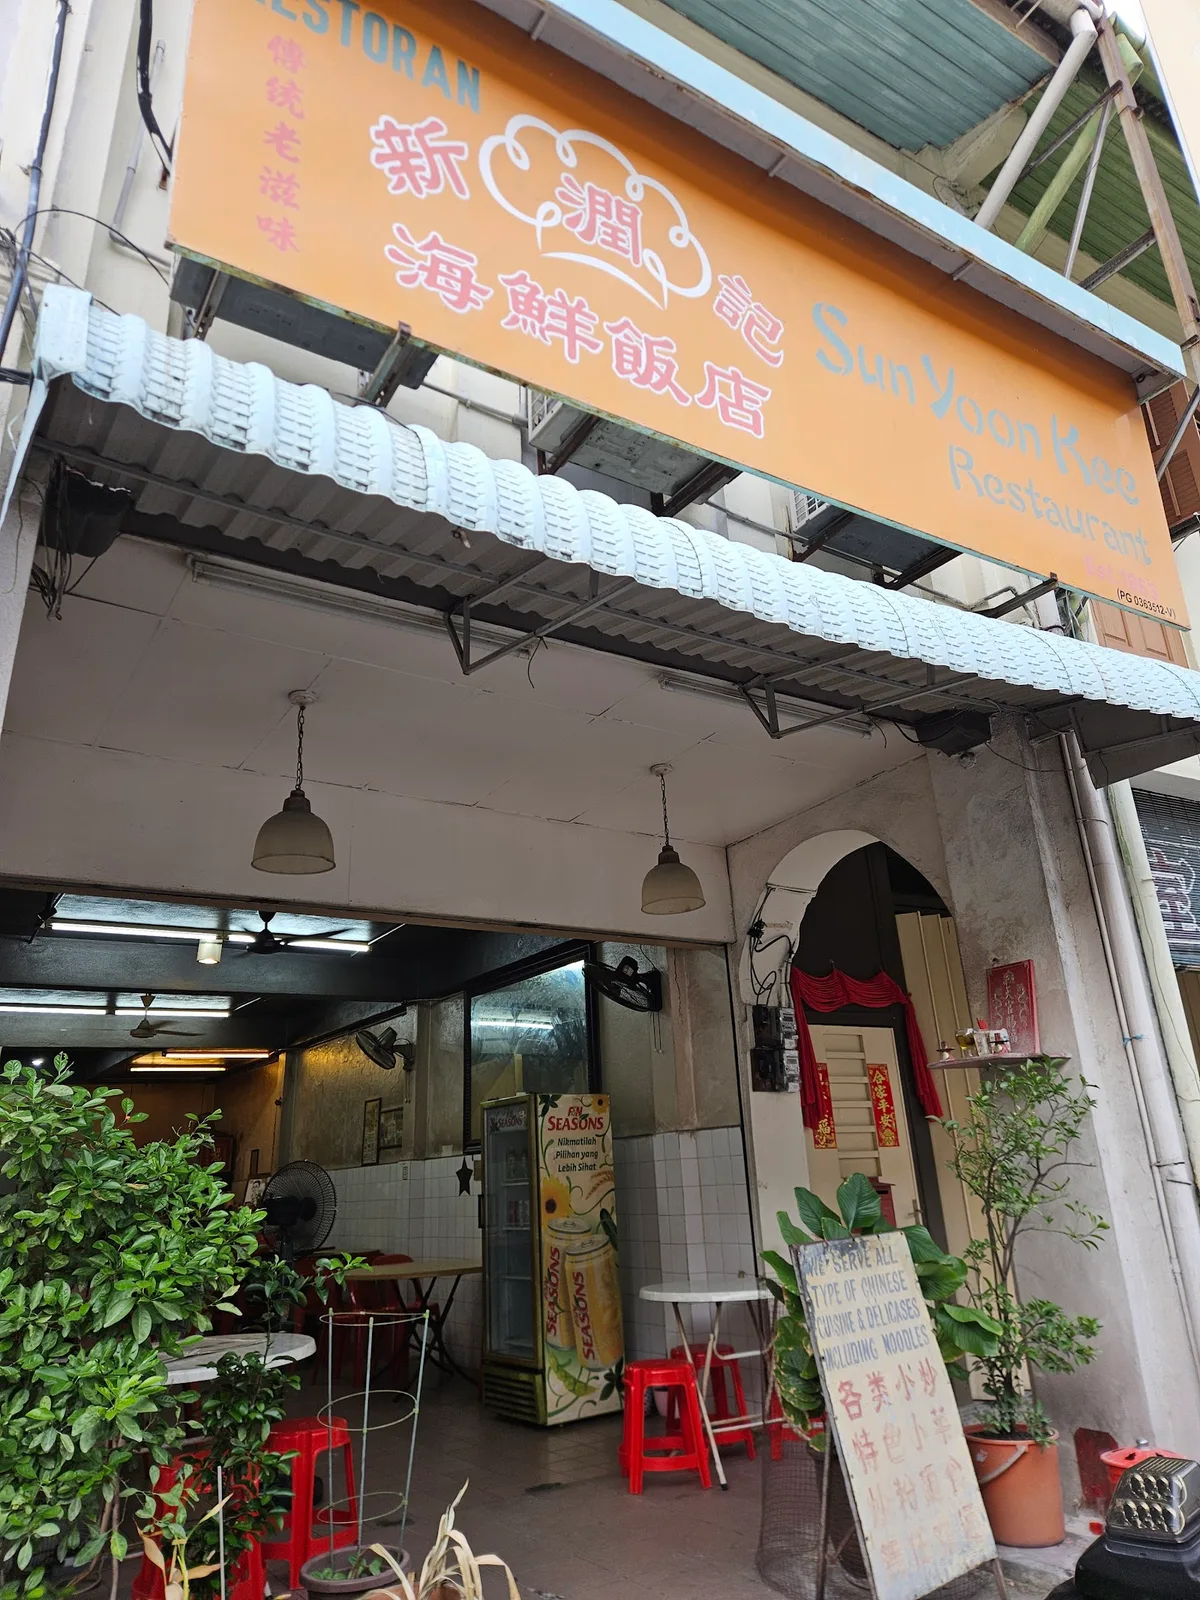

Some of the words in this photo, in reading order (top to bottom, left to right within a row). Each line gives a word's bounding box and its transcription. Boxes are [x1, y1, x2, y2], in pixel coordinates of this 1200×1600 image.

[256, 0, 480, 114] STORAN
[384, 223, 771, 440] 海鮮飯店
[812, 302, 916, 406] Sun
[921, 355, 1042, 461] Yoon
[1051, 414, 1139, 505] Kee
[948, 445, 1151, 565] Restaurant
[1116, 588, 1133, 603] (PG
[872, 1070, 895, 1129] 合家平安
[547, 1116, 604, 1132] SEASONS
[557, 1136, 597, 1147] Nikmatilah
[555, 1150, 580, 1160] Pilihan
[581, 1150, 599, 1161] yang
[558, 1162, 577, 1173] Lebih
[578, 1161, 596, 1172] Sihat
[830, 1246, 872, 1274] SERVE
[876, 1244, 898, 1267] ALL
[546, 1246, 560, 1337] SEASONS
[811, 1281, 842, 1309] TYPE
[844, 1279, 857, 1302] OF
[861, 1270, 908, 1299] CHINESE
[573, 1271, 596, 1361] SEASONS
[817, 1311, 856, 1340] CUISINE
[857, 1308, 867, 1332] &
[823, 1337, 879, 1371] INCLUDING
[881, 1324, 930, 1356] NOODLES
